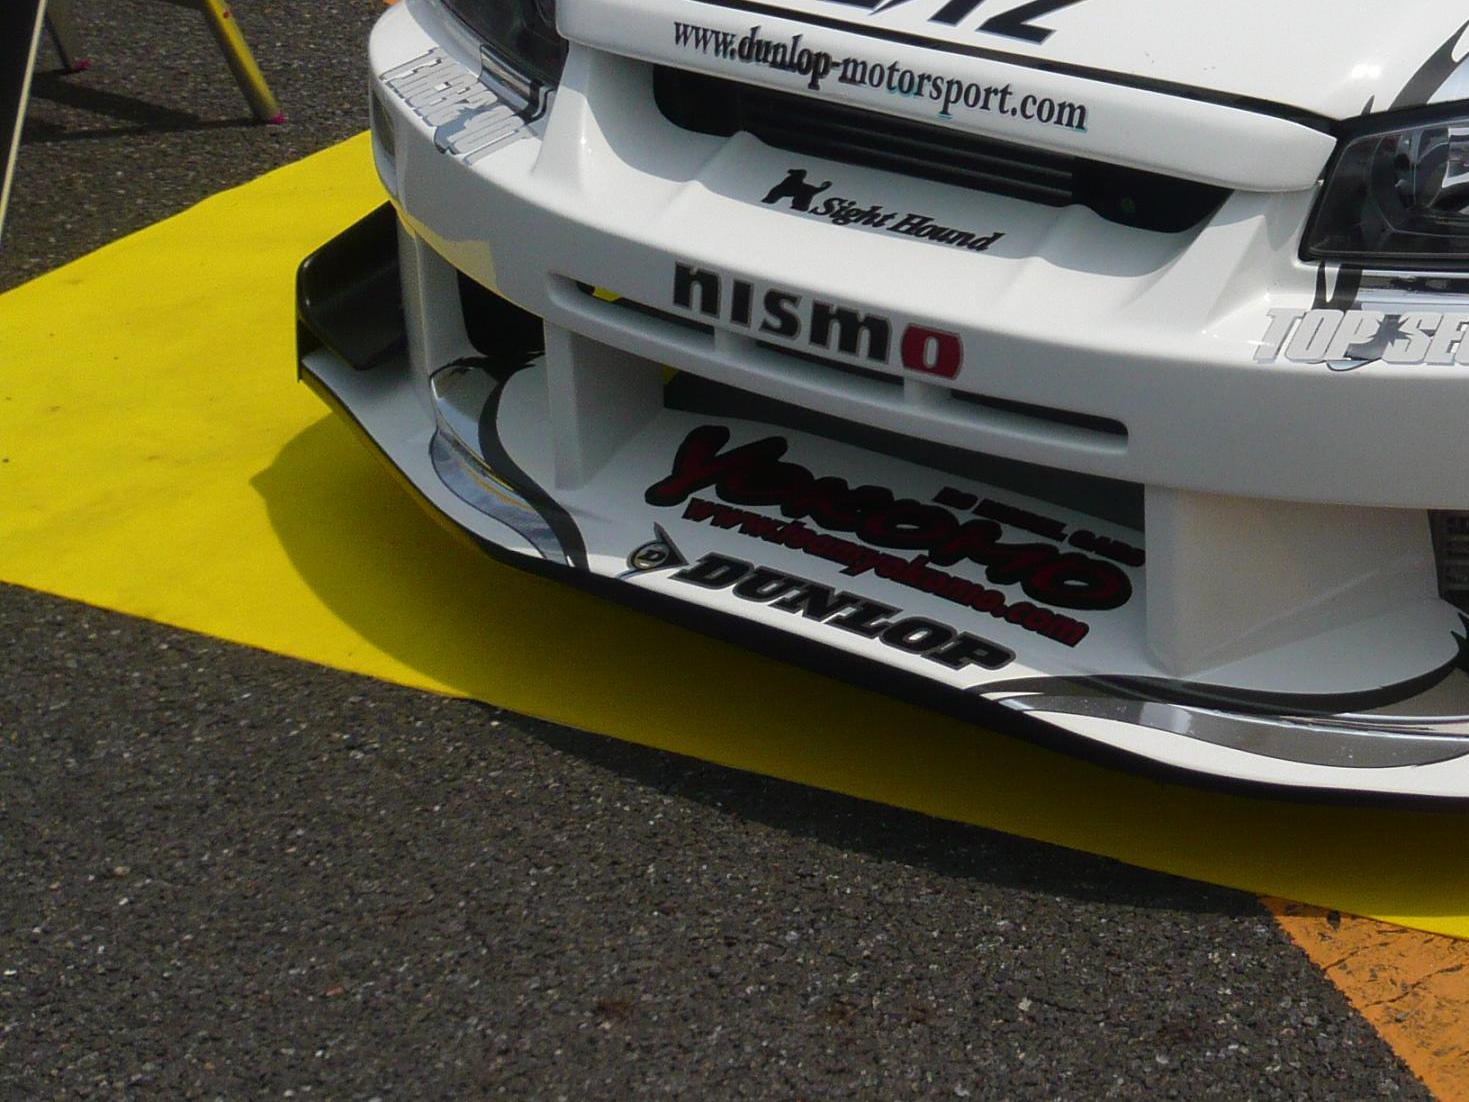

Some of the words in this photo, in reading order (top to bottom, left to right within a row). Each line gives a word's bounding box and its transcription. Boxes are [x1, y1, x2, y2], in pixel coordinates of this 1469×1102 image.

[673, 15, 1090, 133] www.dunlop-motorsport.com
[811, 196, 893, 232] Sight
[894, 213, 1005, 253] Hound
[672, 259, 965, 382] nismo
[1252, 307, 1385, 365] TOP
[669, 550, 1017, 672] DUNLOP
